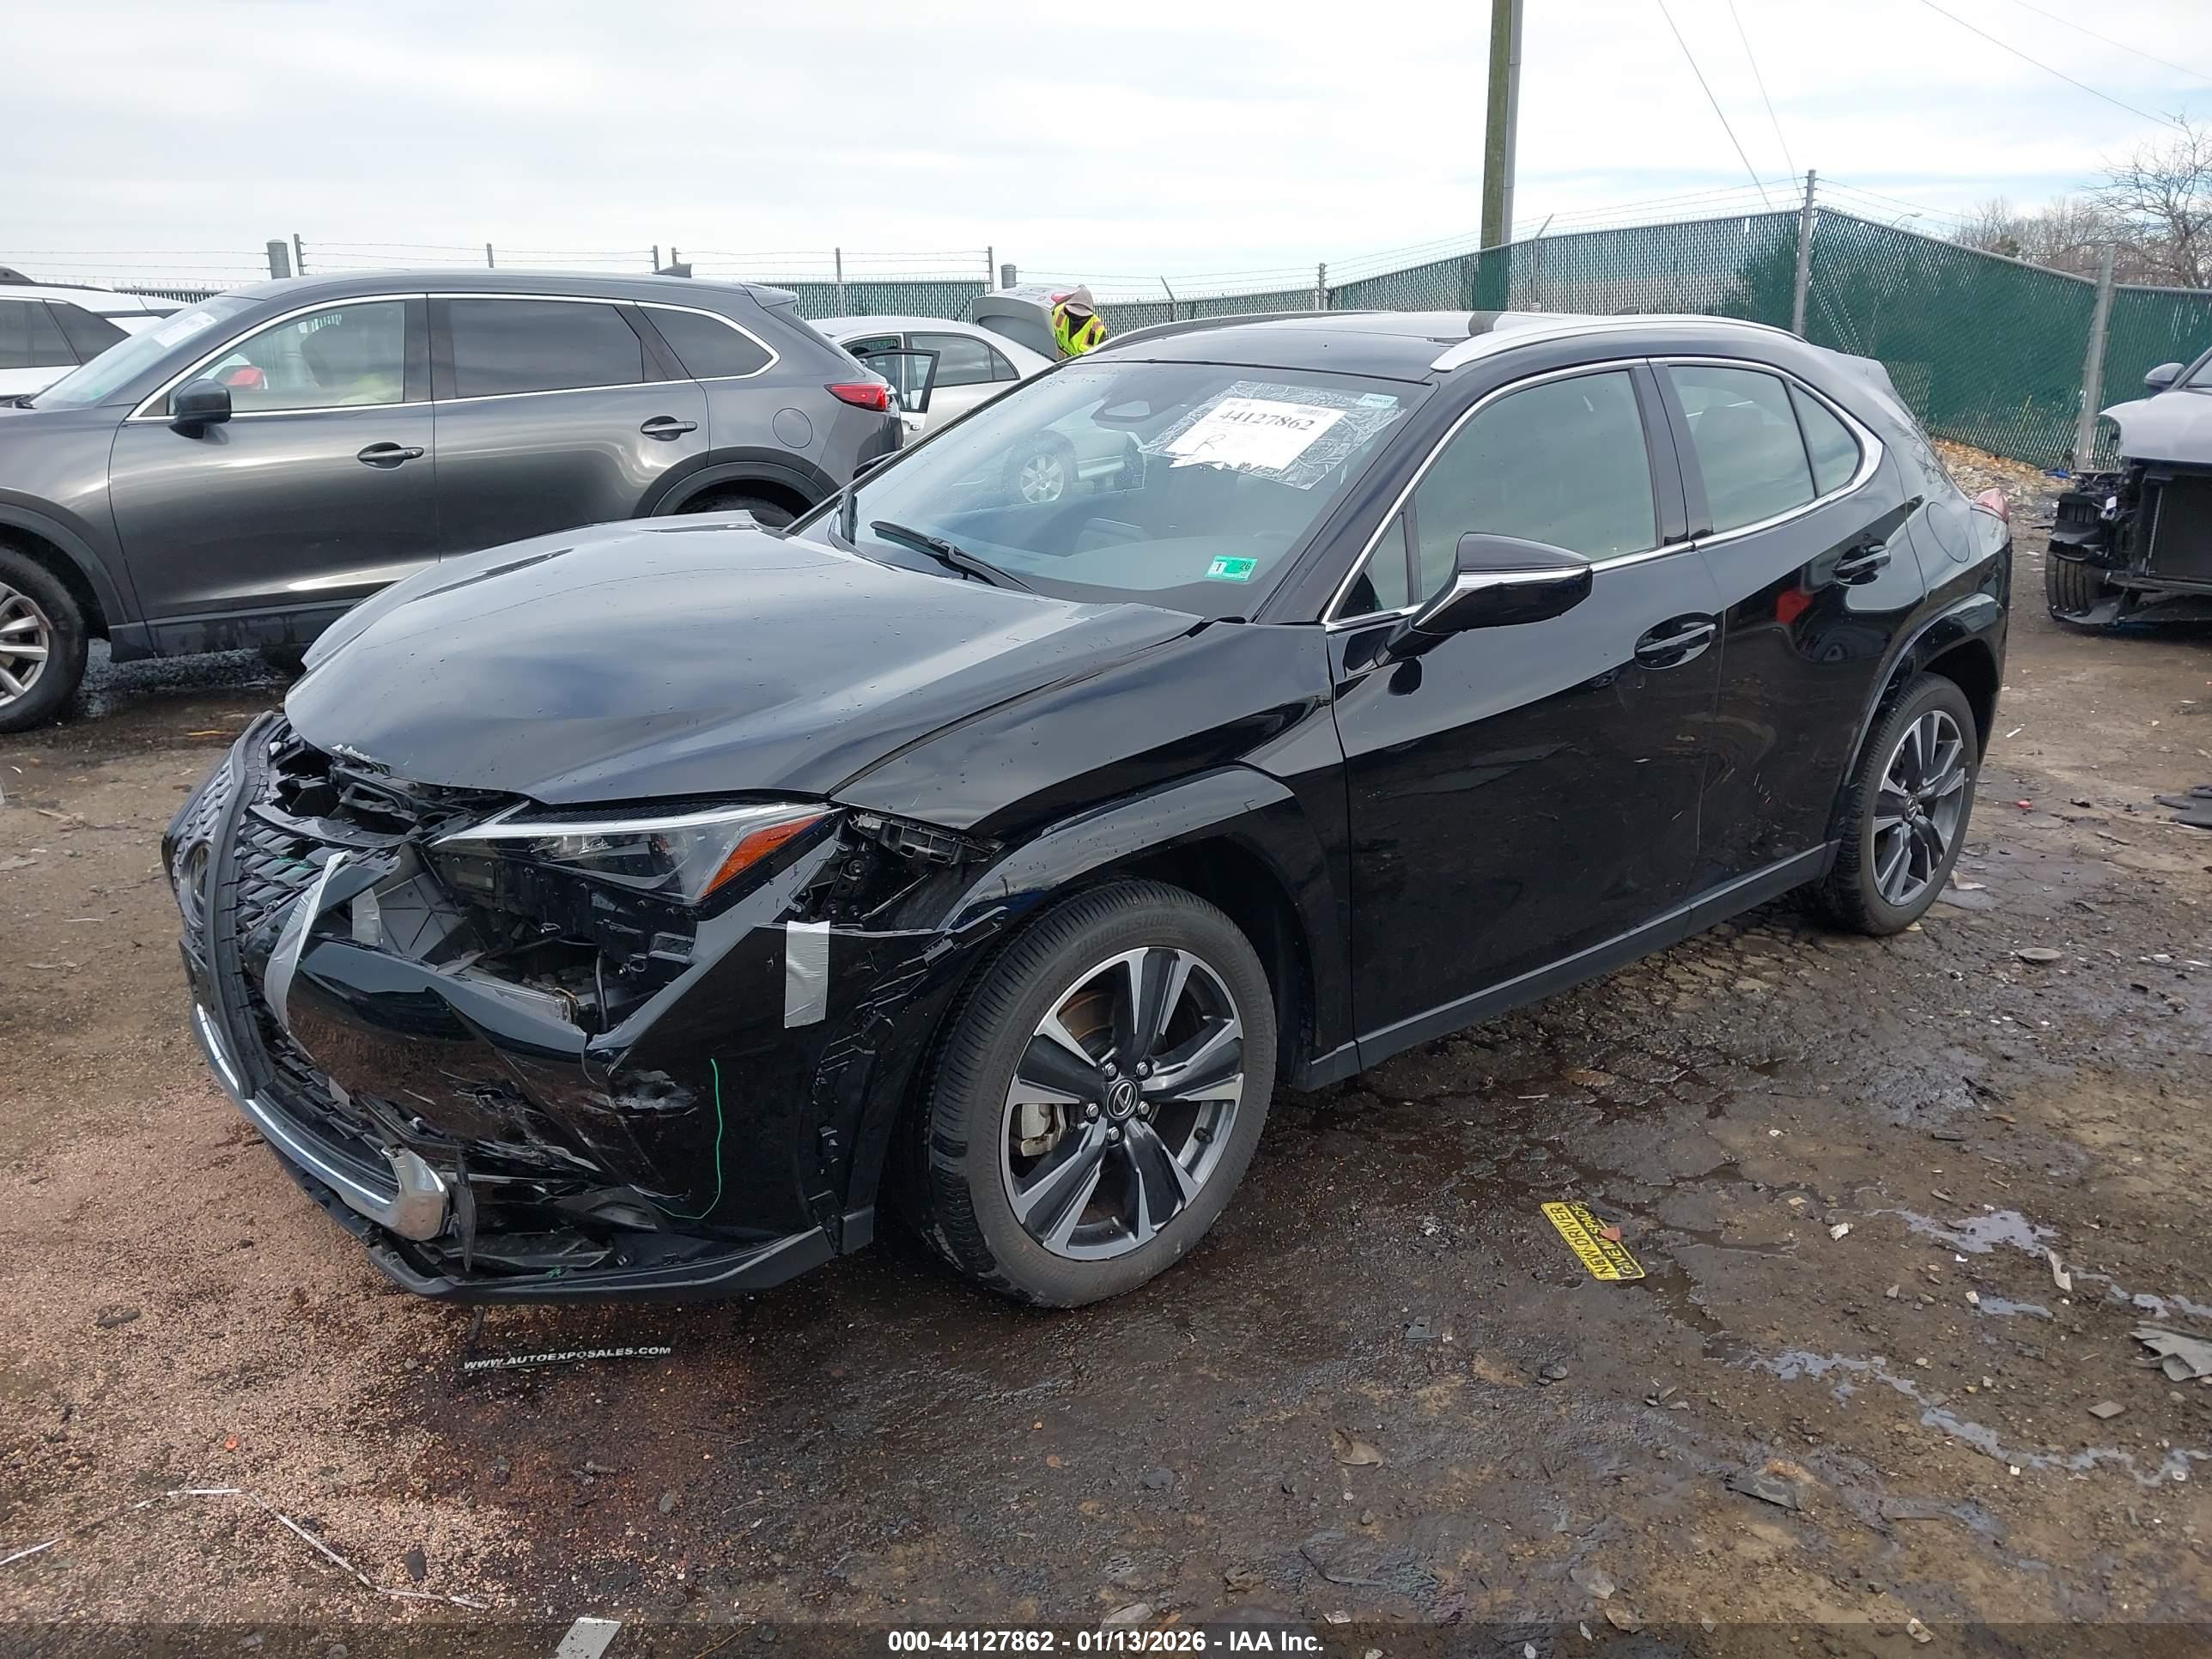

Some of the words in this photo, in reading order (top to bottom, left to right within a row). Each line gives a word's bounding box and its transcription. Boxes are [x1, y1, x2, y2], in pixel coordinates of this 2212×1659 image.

[1218, 410, 1316, 431] 44127862
[1550, 1206, 1589, 1245] DRIVER
[1570, 1204, 1602, 1236] SPACE
[1582, 1248, 1612, 1274] NEW
[1606, 1249, 1633, 1274] GIVE
[464, 1346, 672, 1370] WWW.AUTOEXPOSALES.COM
